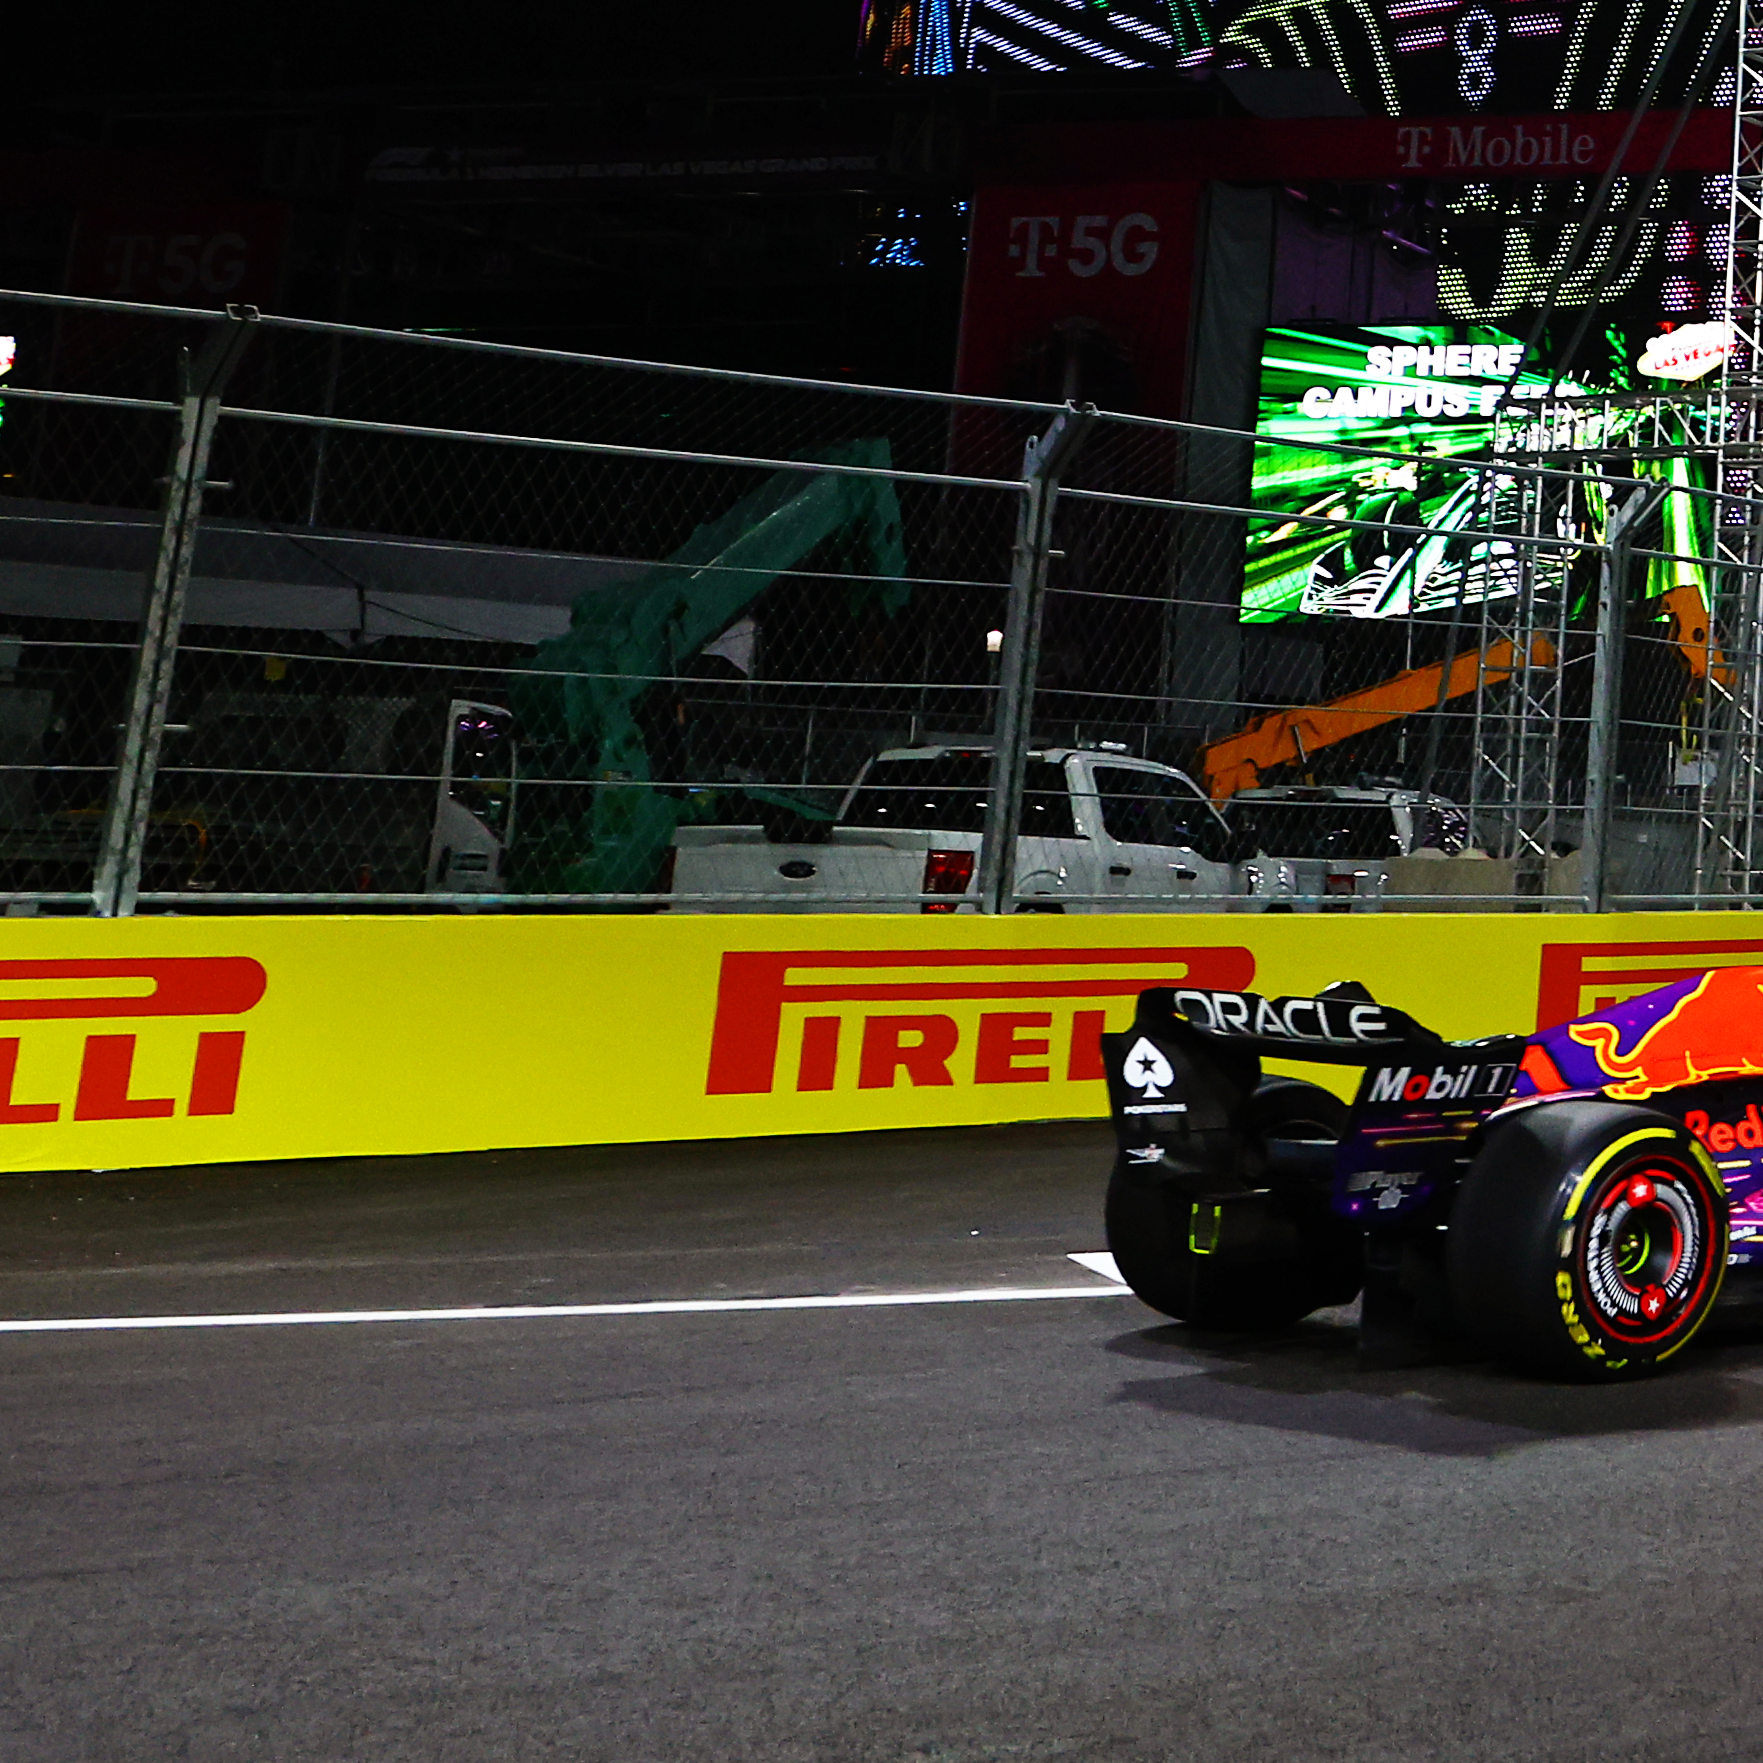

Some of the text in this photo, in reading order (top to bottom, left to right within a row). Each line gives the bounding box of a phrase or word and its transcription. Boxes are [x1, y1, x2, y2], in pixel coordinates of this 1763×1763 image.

[1446, 124, 1596, 168] Mobile
[1067, 212, 1160, 278] 5G
[1365, 344, 1525, 378] SPHERE
[1301, 386, 1470, 419] CAMPUS
[1174, 990, 1398, 1043] ORACLE
[1369, 1065, 1504, 1102] Mobil 1
